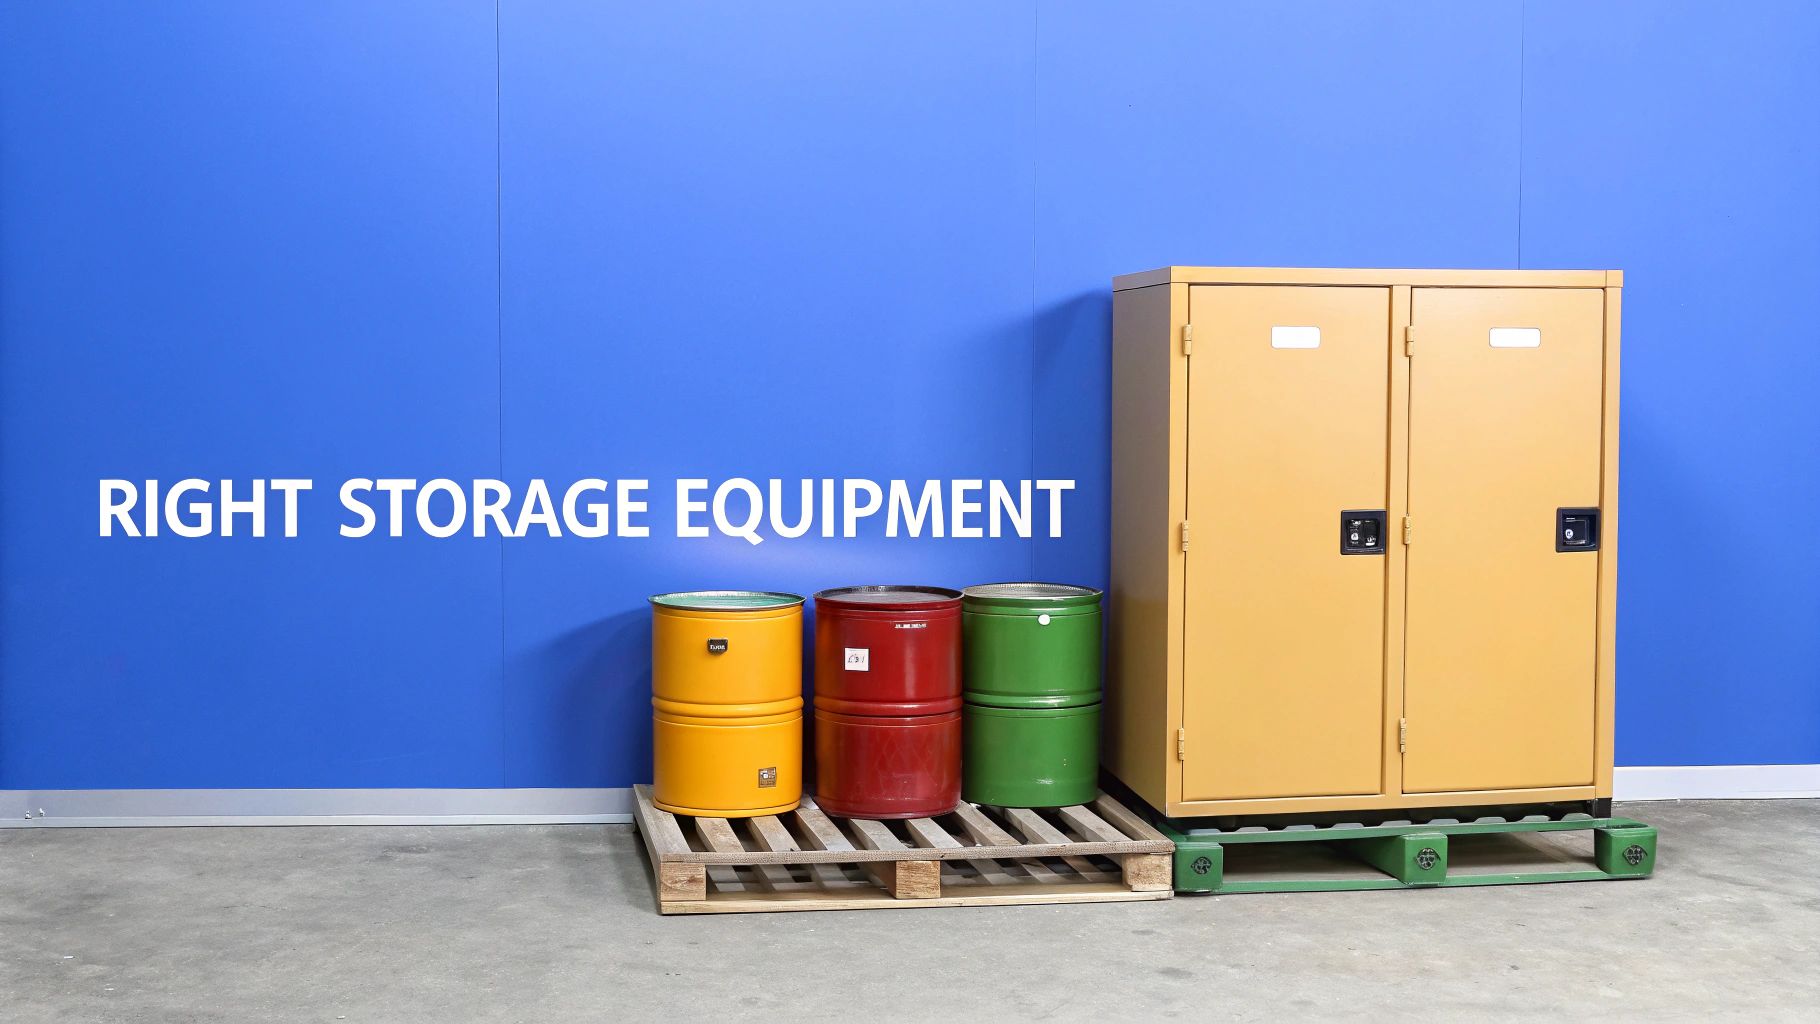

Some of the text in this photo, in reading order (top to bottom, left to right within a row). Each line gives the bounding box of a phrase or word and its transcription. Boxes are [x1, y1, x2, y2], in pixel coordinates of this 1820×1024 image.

[99, 477, 1076, 546] RIGHT STORAGE EQUIPMENT
